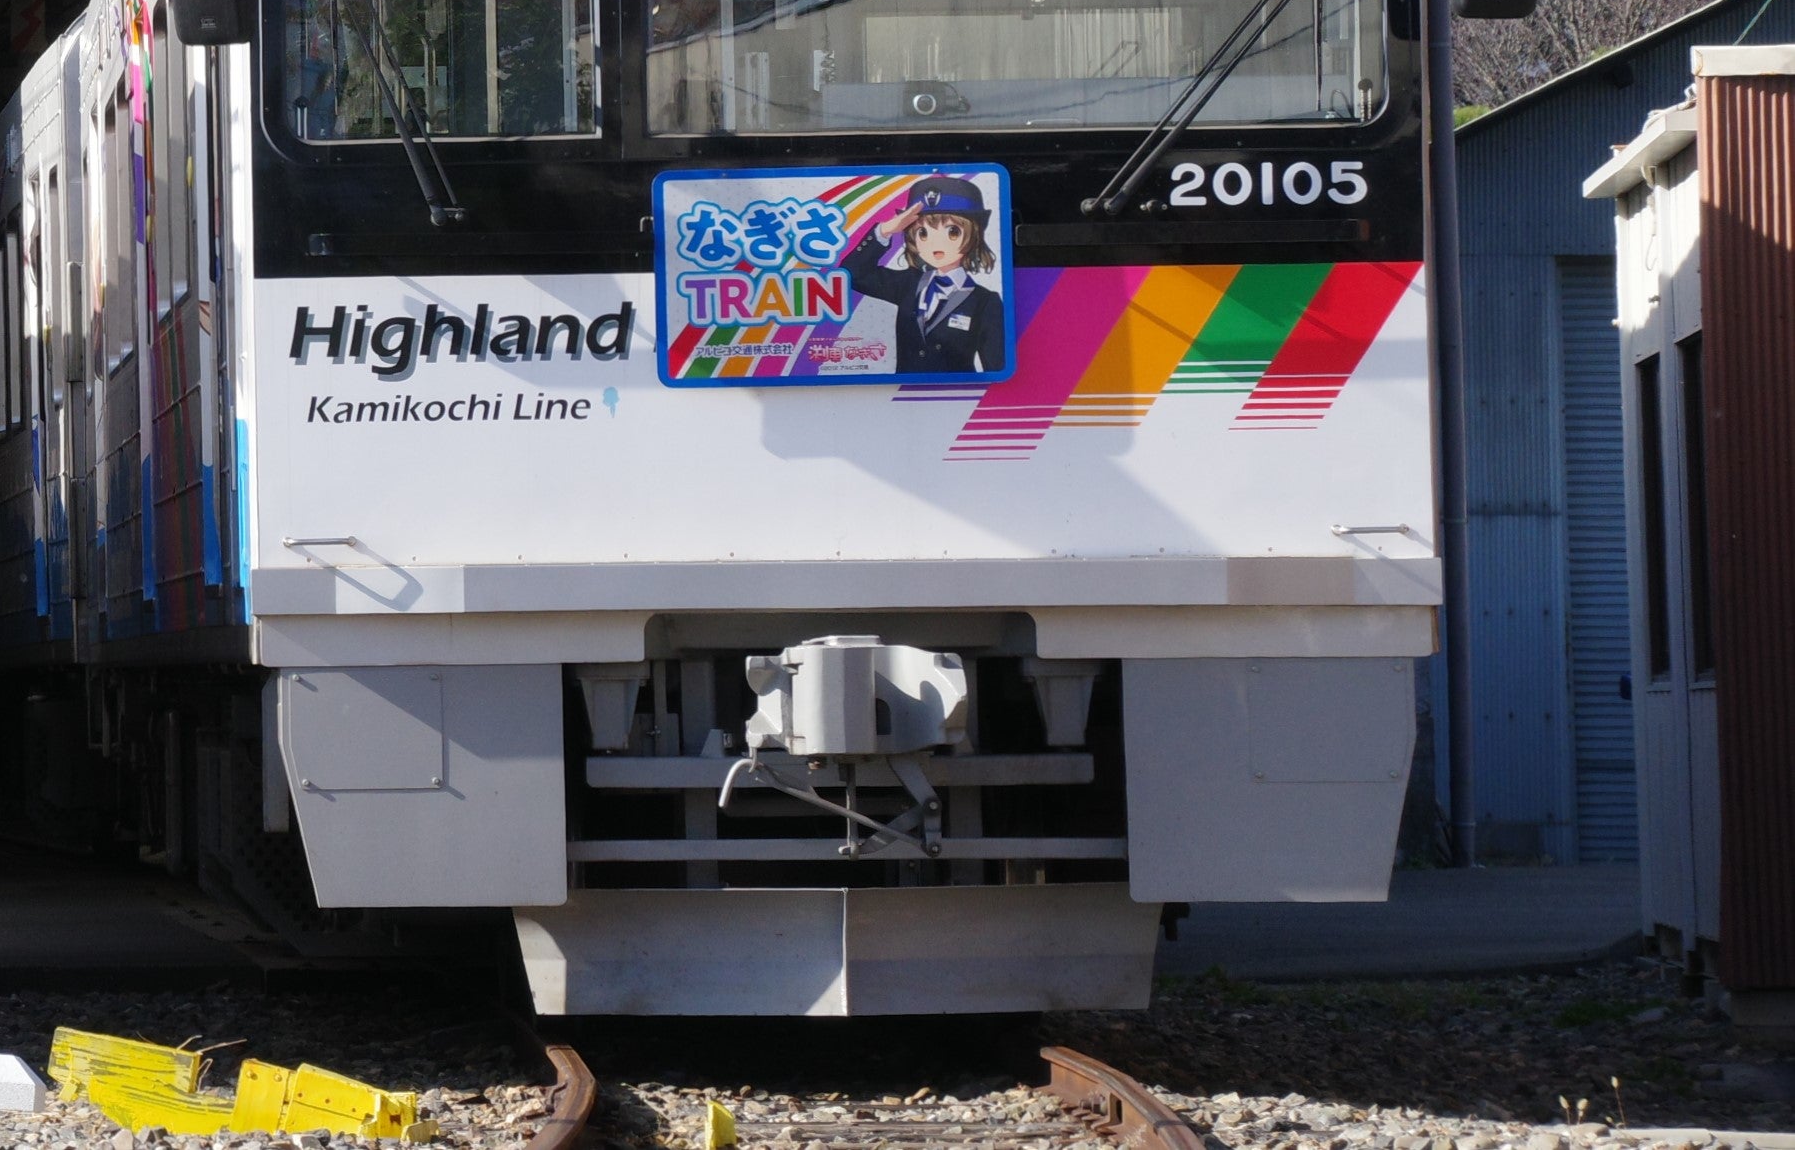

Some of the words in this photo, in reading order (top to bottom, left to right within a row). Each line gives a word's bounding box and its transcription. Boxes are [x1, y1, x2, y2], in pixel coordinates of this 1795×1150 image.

[1168, 160, 1368, 207] 20105
[684, 204, 845, 263] なぎさ
[684, 276, 843, 320] TRAIN
[289, 301, 635, 379] Highland
[695, 344, 793, 357] アルピコ交通株式会社
[306, 392, 503, 424] Kamikochi
[512, 392, 592, 421] Line
